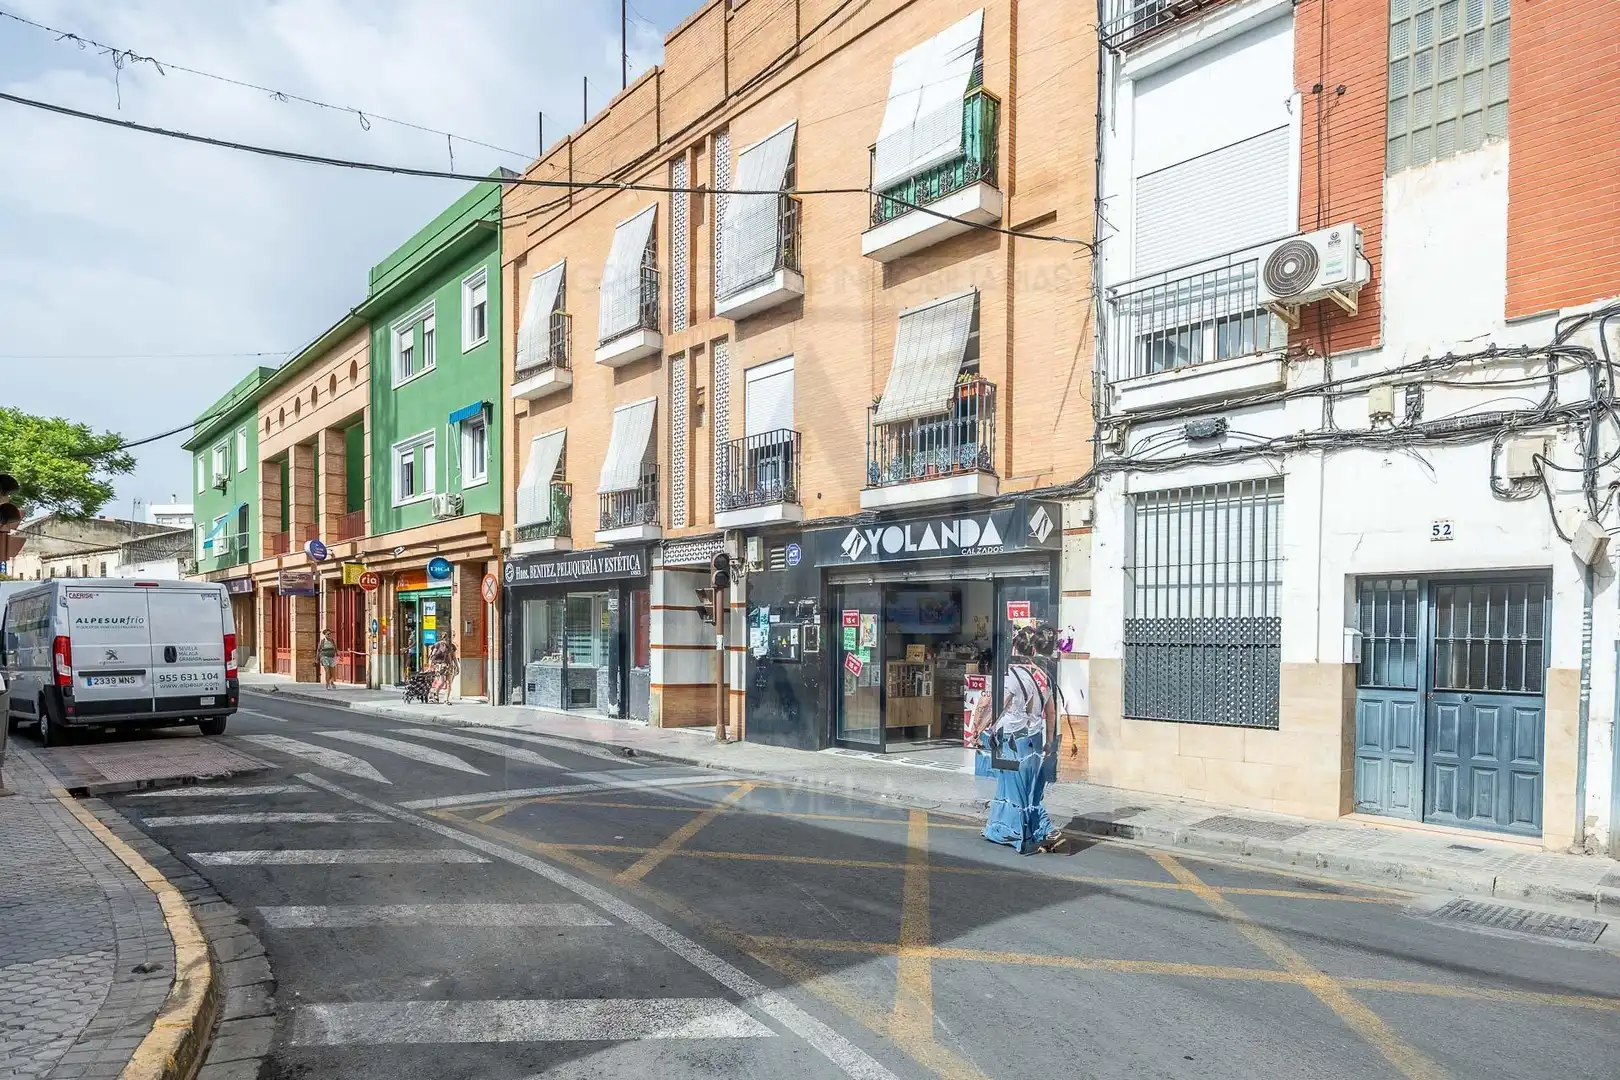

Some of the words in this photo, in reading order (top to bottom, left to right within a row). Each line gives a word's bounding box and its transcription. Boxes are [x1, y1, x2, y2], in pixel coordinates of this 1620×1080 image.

[1432, 524, 1452, 536] 52
[864, 516, 1003, 556] YOLANDA
[961, 545, 1005, 556] CALZADOS
[556, 555, 598, 578] PELUQUERÍA
[598, 557, 605, 573] Y
[604, 552, 641, 572] ESTÉTICA
[361, 574, 377, 584] ria
[93, 677, 116, 685] 2339
[118, 676, 136, 684] MNS
[159, 674, 178, 682] 955
[180, 673, 198, 681] 631
[201, 672, 219, 680] 104
